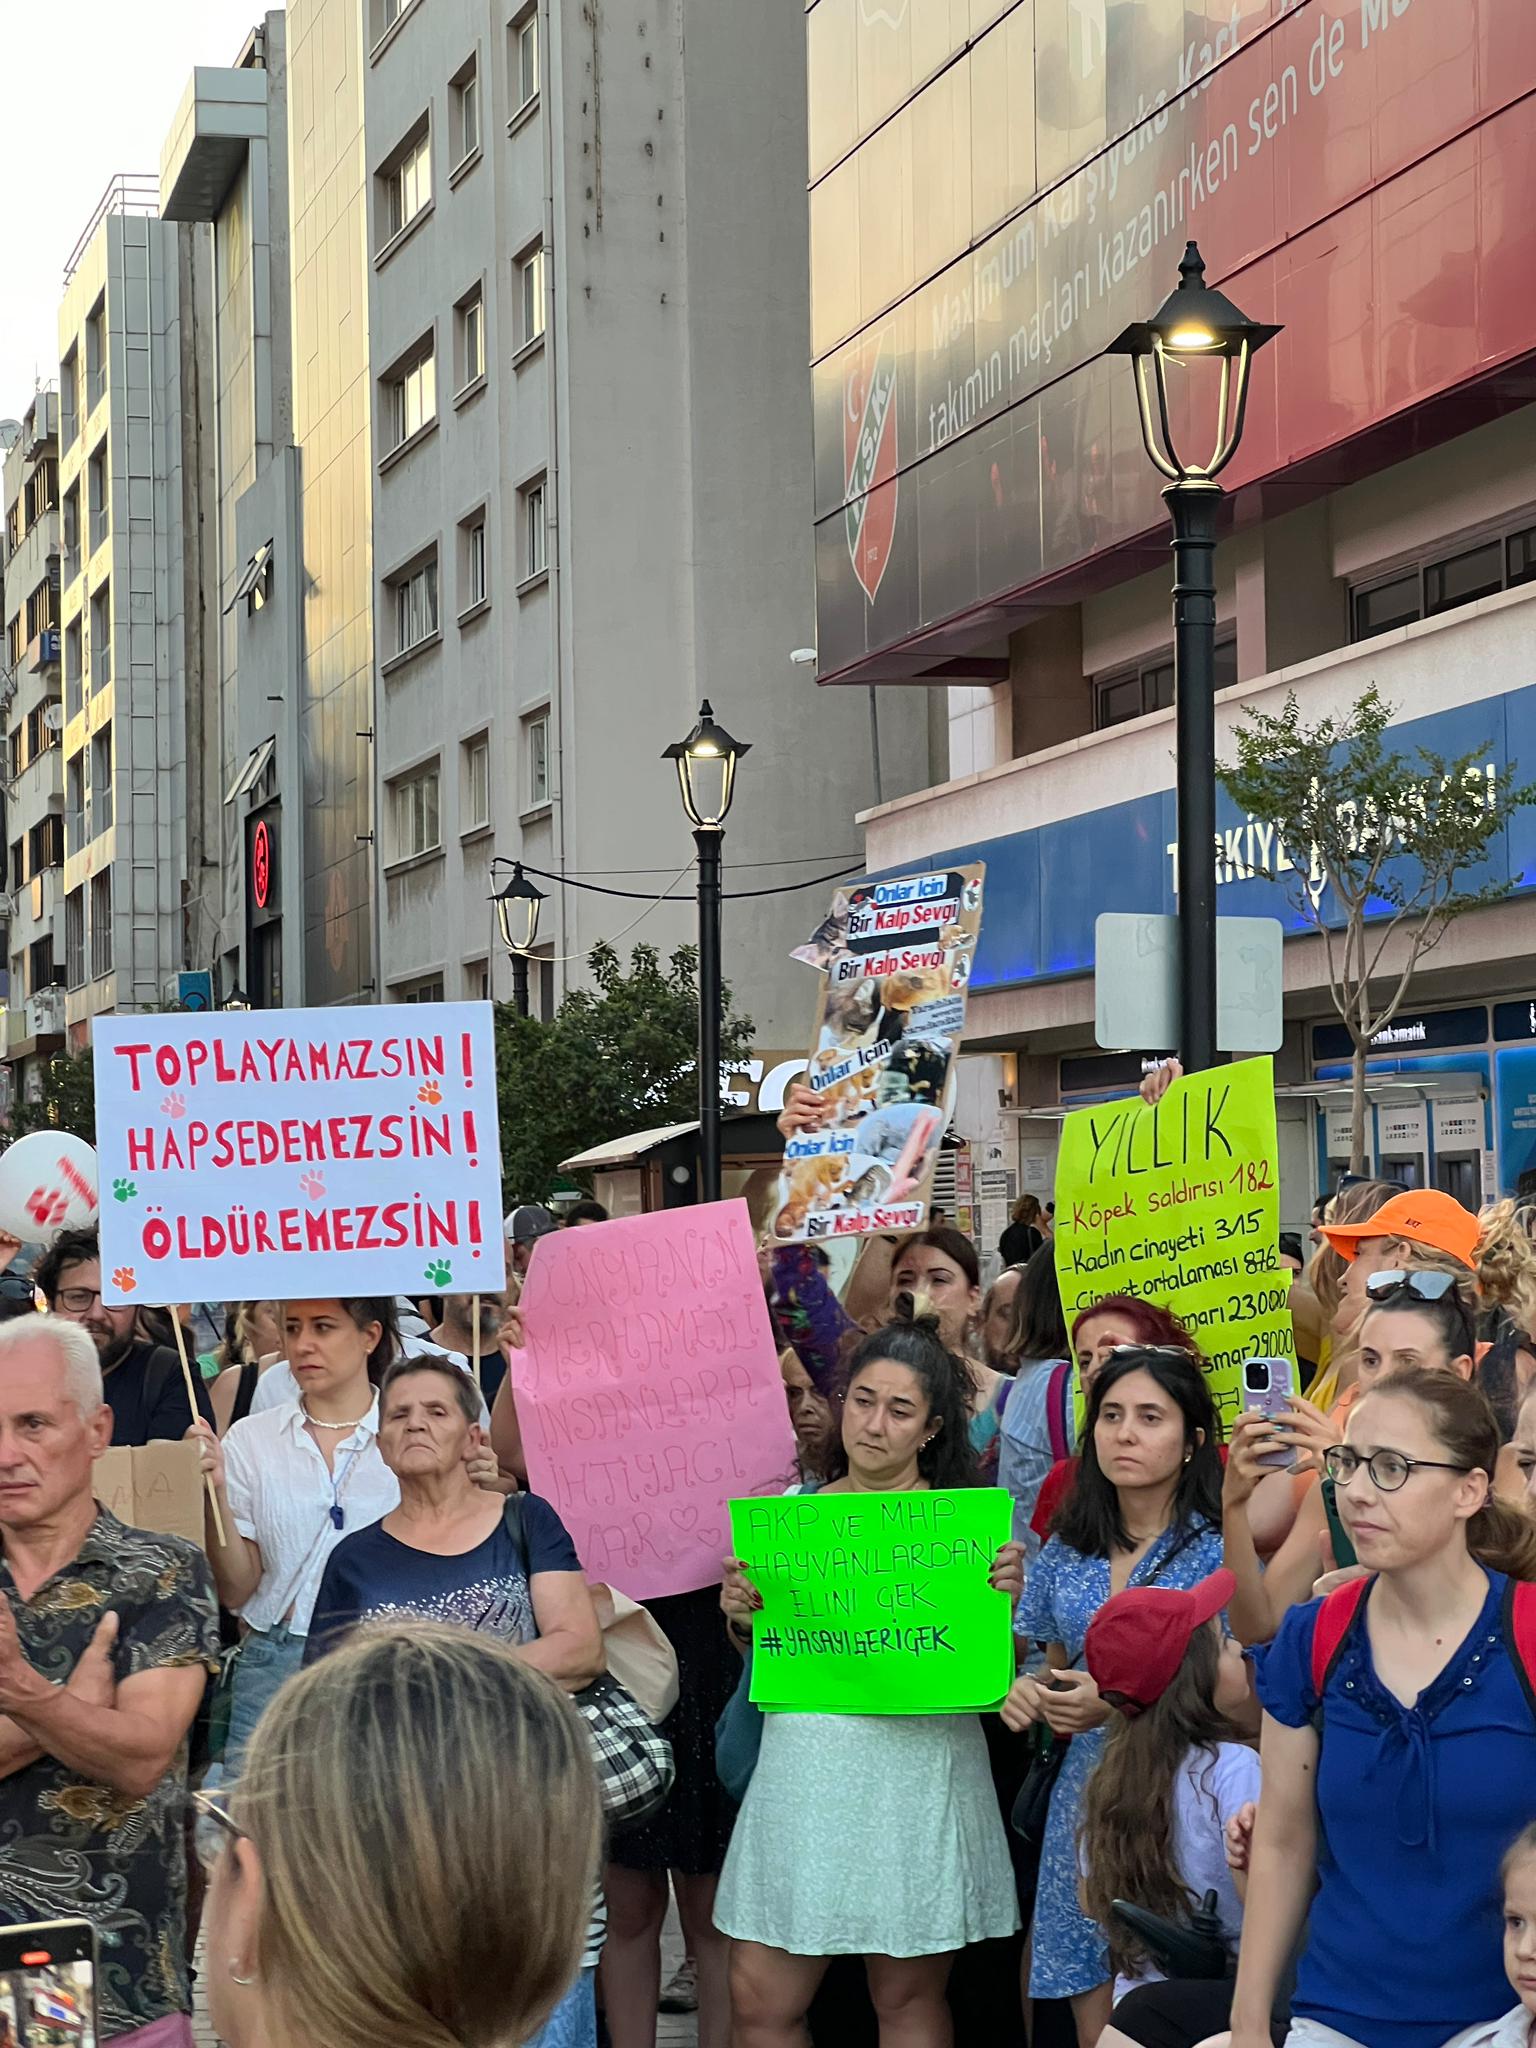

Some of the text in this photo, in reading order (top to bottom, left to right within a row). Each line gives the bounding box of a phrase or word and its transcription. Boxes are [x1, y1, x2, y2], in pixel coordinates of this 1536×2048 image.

[931, 217, 1036, 359] Maximum
[1176, 3, 1242, 112] Kart
[929, 350, 1002, 454] takımın
[1008, 262, 1090, 381] maçları
[1098, 122, 1238, 297] kazanırken
[1248, 64, 1298, 156] sen
[1308, 14, 1345, 96] de
[1166, 814, 1296, 894] TRKİYE
[876, 884, 915, 904] Onlar
[849, 898, 957, 934] Bir Kalp Sevgi
[838, 950, 945, 981] Bir Kalp Sevgi
[810, 1060, 852, 1091] Onlar
[1088, 1084, 1233, 1184] YILLIK
[1229, 1159, 1274, 1194] 182
[807, 1216, 830, 1237] Bir
[833, 1208, 870, 1234] Kalp
[1130, 1225, 1205, 1262] cinayeti
[1214, 1208, 1265, 1241] 315
[1243, 1243, 1280, 1275] 876
[1227, 1288, 1286, 1322] 23000
[1248, 1328, 1293, 1359] 29000
[532, 1365, 759, 1451] İNSANLARA
[749, 1502, 820, 1543] AKP
[880, 1497, 957, 1533] MHP
[750, 1536, 996, 1583] HAYVANLARDAN
